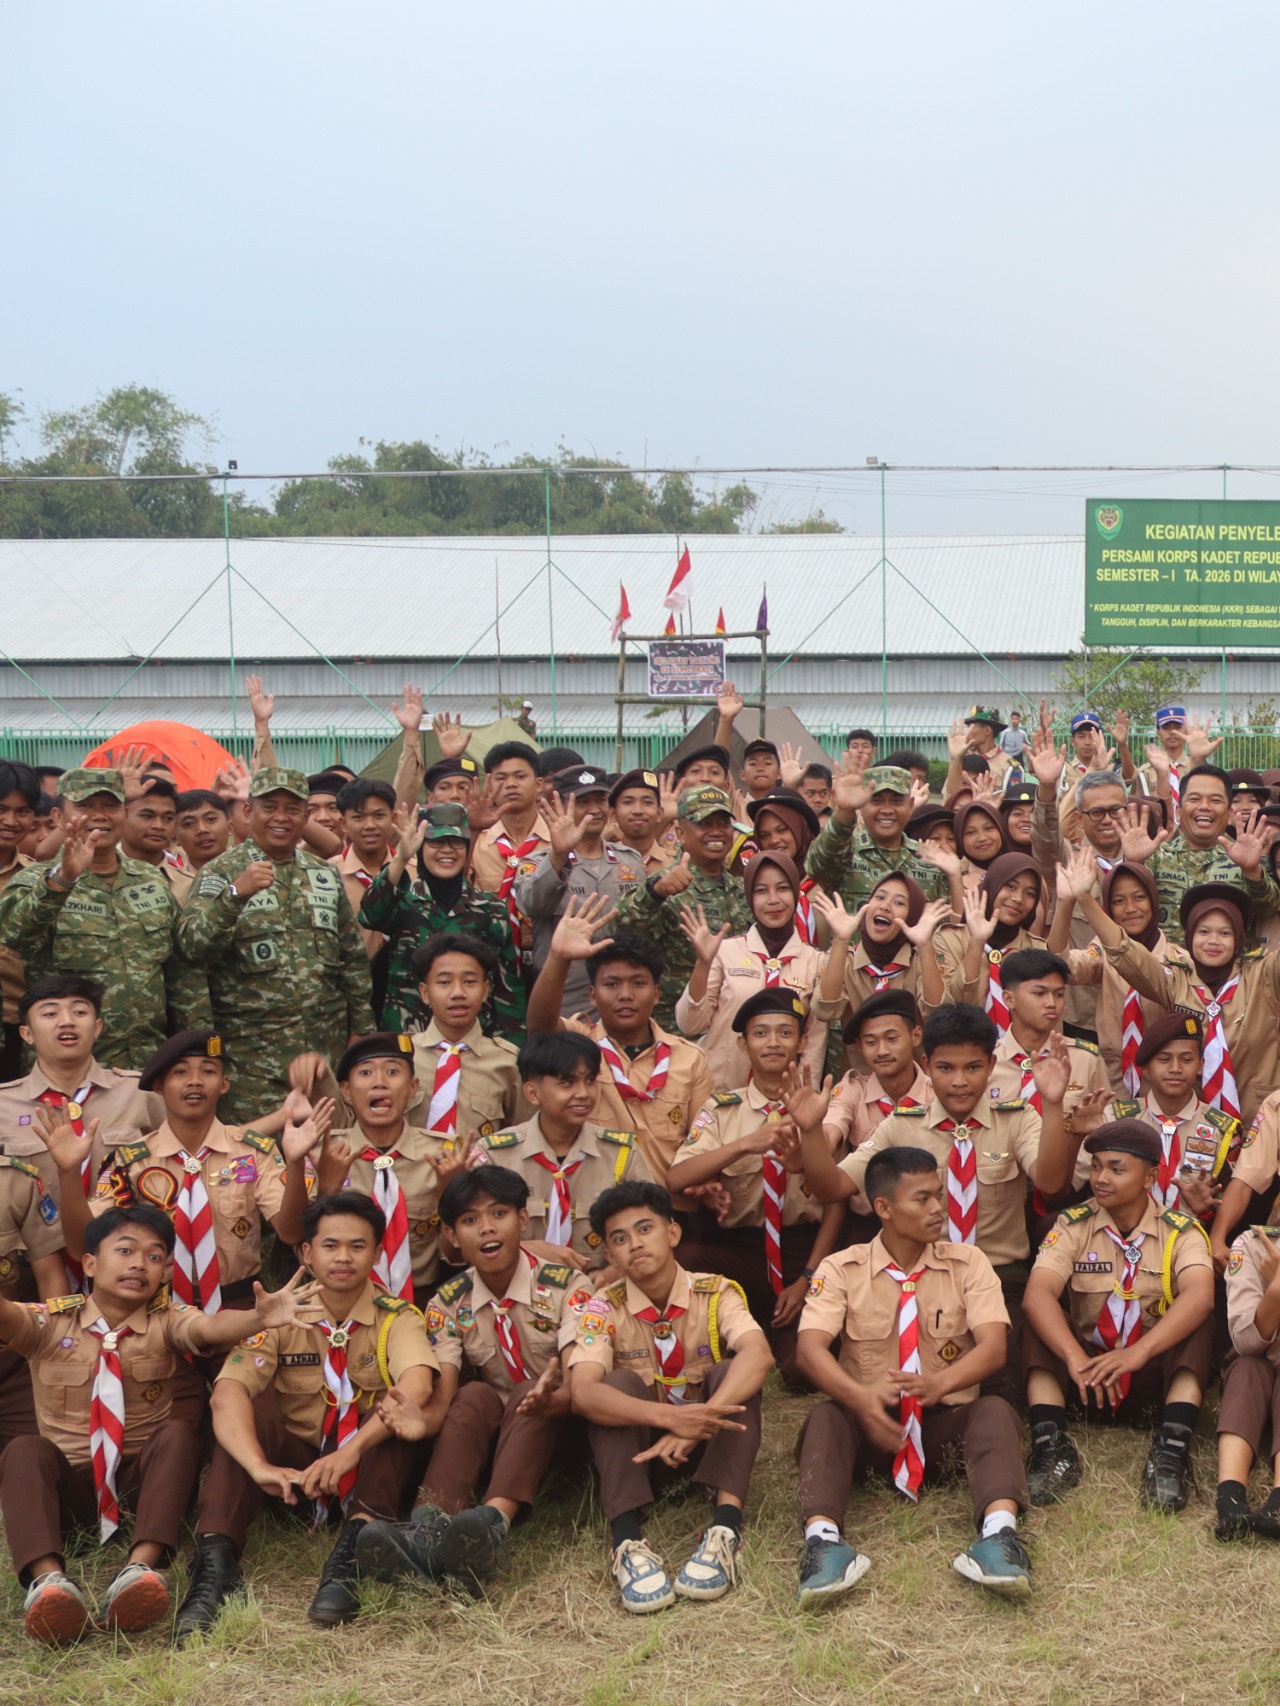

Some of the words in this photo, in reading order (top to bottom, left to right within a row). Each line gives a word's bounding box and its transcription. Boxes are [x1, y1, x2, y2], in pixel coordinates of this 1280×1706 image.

[1146, 525, 1216, 540] KEGIATAN
[1102, 550, 1154, 562] PERSAMI
[1157, 550, 1198, 563] KORPS
[1200, 551, 1240, 563] KADET
[1096, 569, 1160, 581] SEMESTER
[1184, 569, 1202, 581] TA.
[1204, 570, 1231, 582] 2026
[1234, 570, 1245, 582] DI
[1094, 604, 1119, 612] KORPS
[1120, 604, 1144, 612] KADET
[1145, 604, 1181, 612] REPUBLIK
[1182, 605, 1221, 613] INDONESIA
[1222, 605, 1244, 614] (KKRI)
[1245, 605, 1278, 613] SEBAGAI
[1188, 619, 1242, 627] BERKARAKTER
[912, 871, 927, 879] TNI
[66, 902, 102, 914] ZKHARI
[135, 902, 151, 910] TNI
[155, 897, 167, 905] AD
[248, 898, 274, 908] AYA
[1077, 1263, 1109, 1272] FAIZAL
